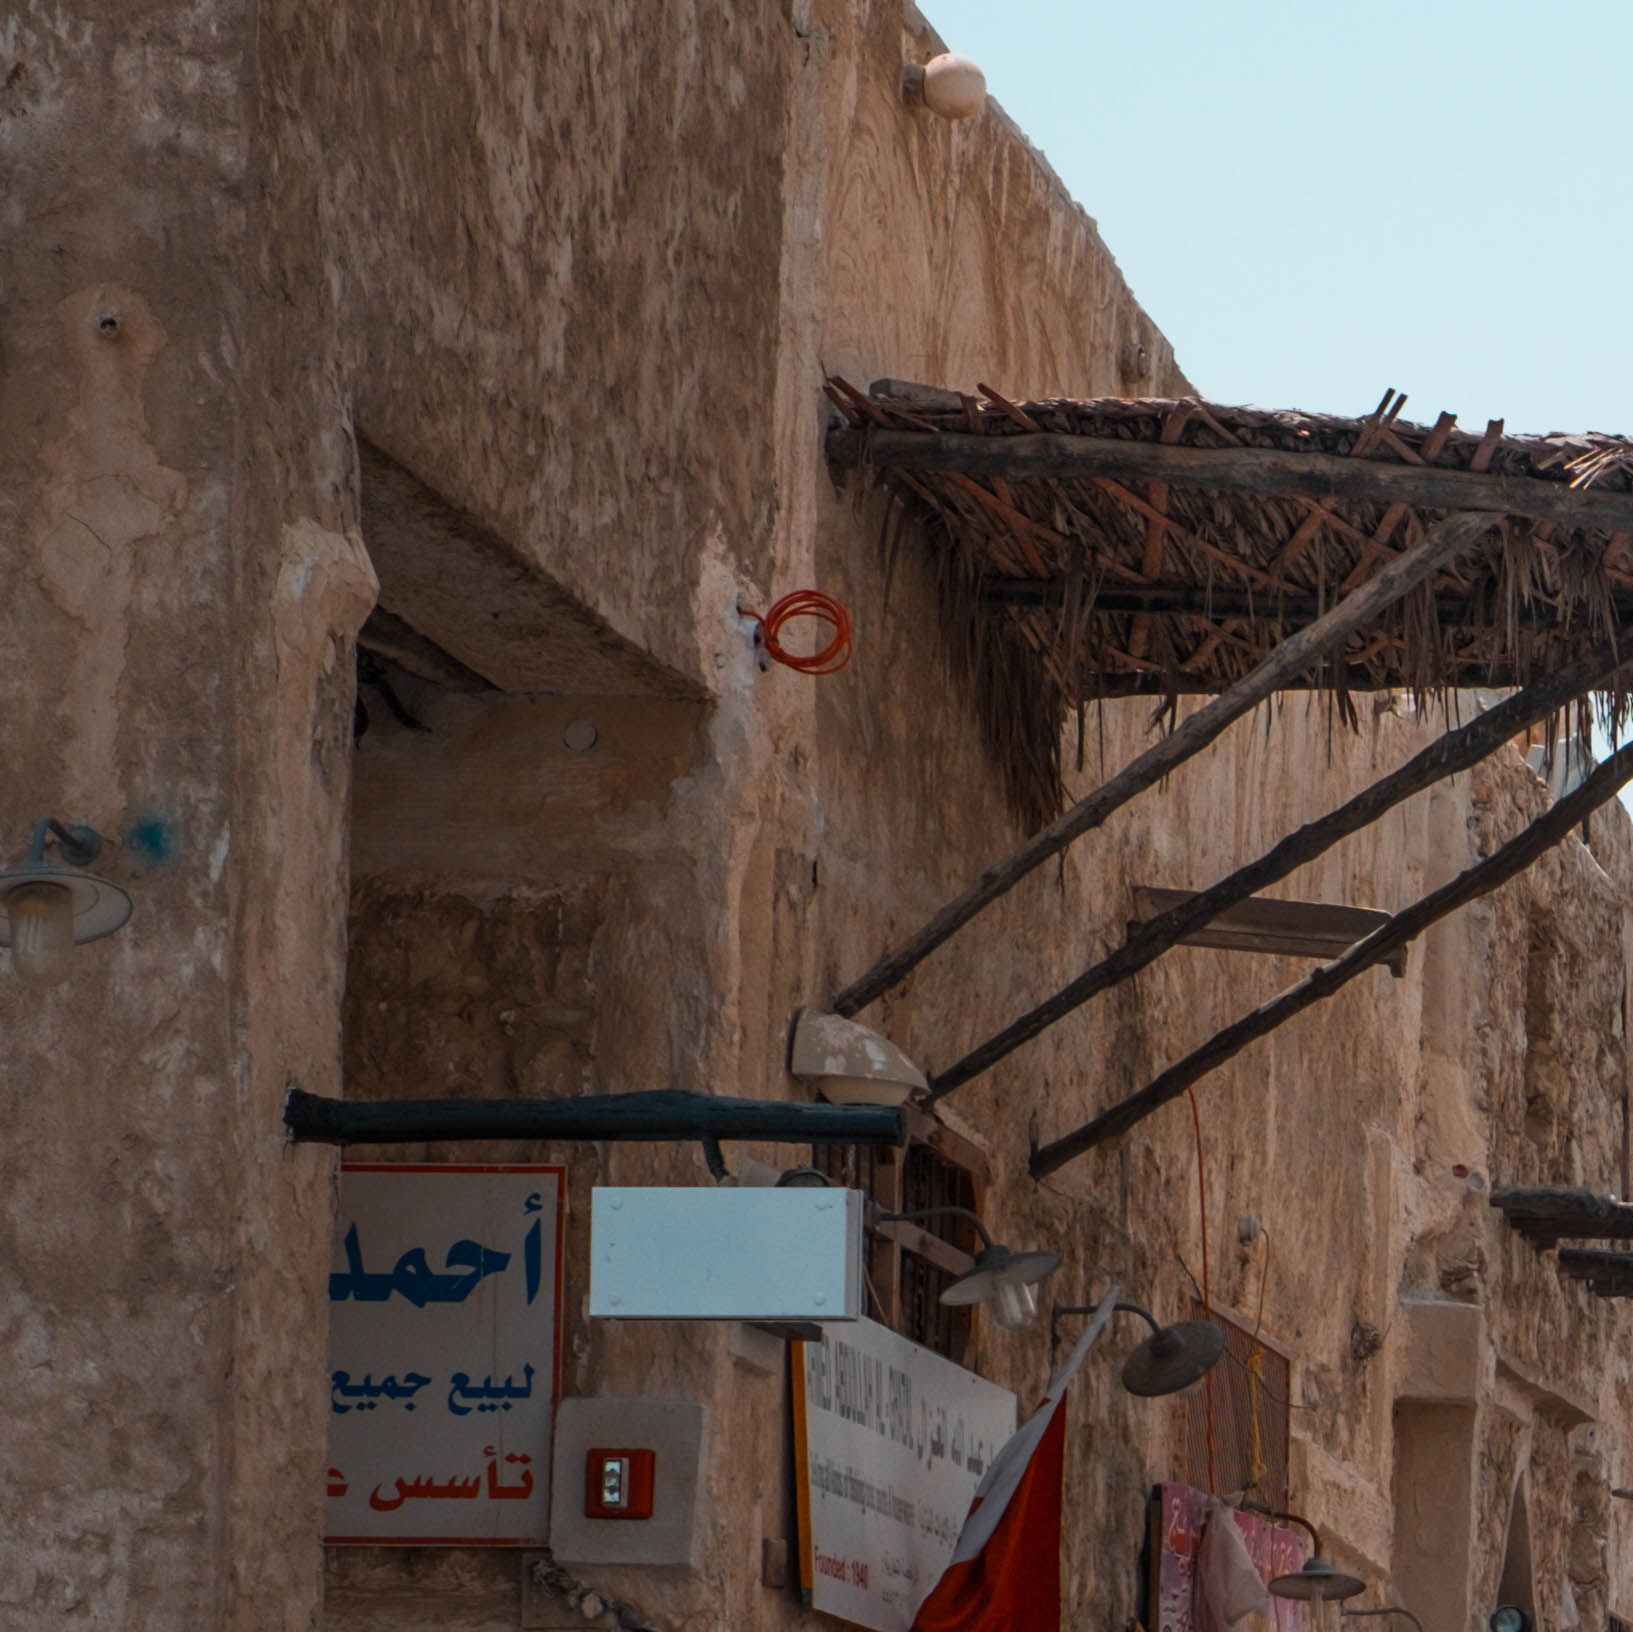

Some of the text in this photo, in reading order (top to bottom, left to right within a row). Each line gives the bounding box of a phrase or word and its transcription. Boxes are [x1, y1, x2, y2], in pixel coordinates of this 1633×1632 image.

[330, 1362, 536, 1416] لبيع جميع
[369, 1445, 534, 1512] تأسس
